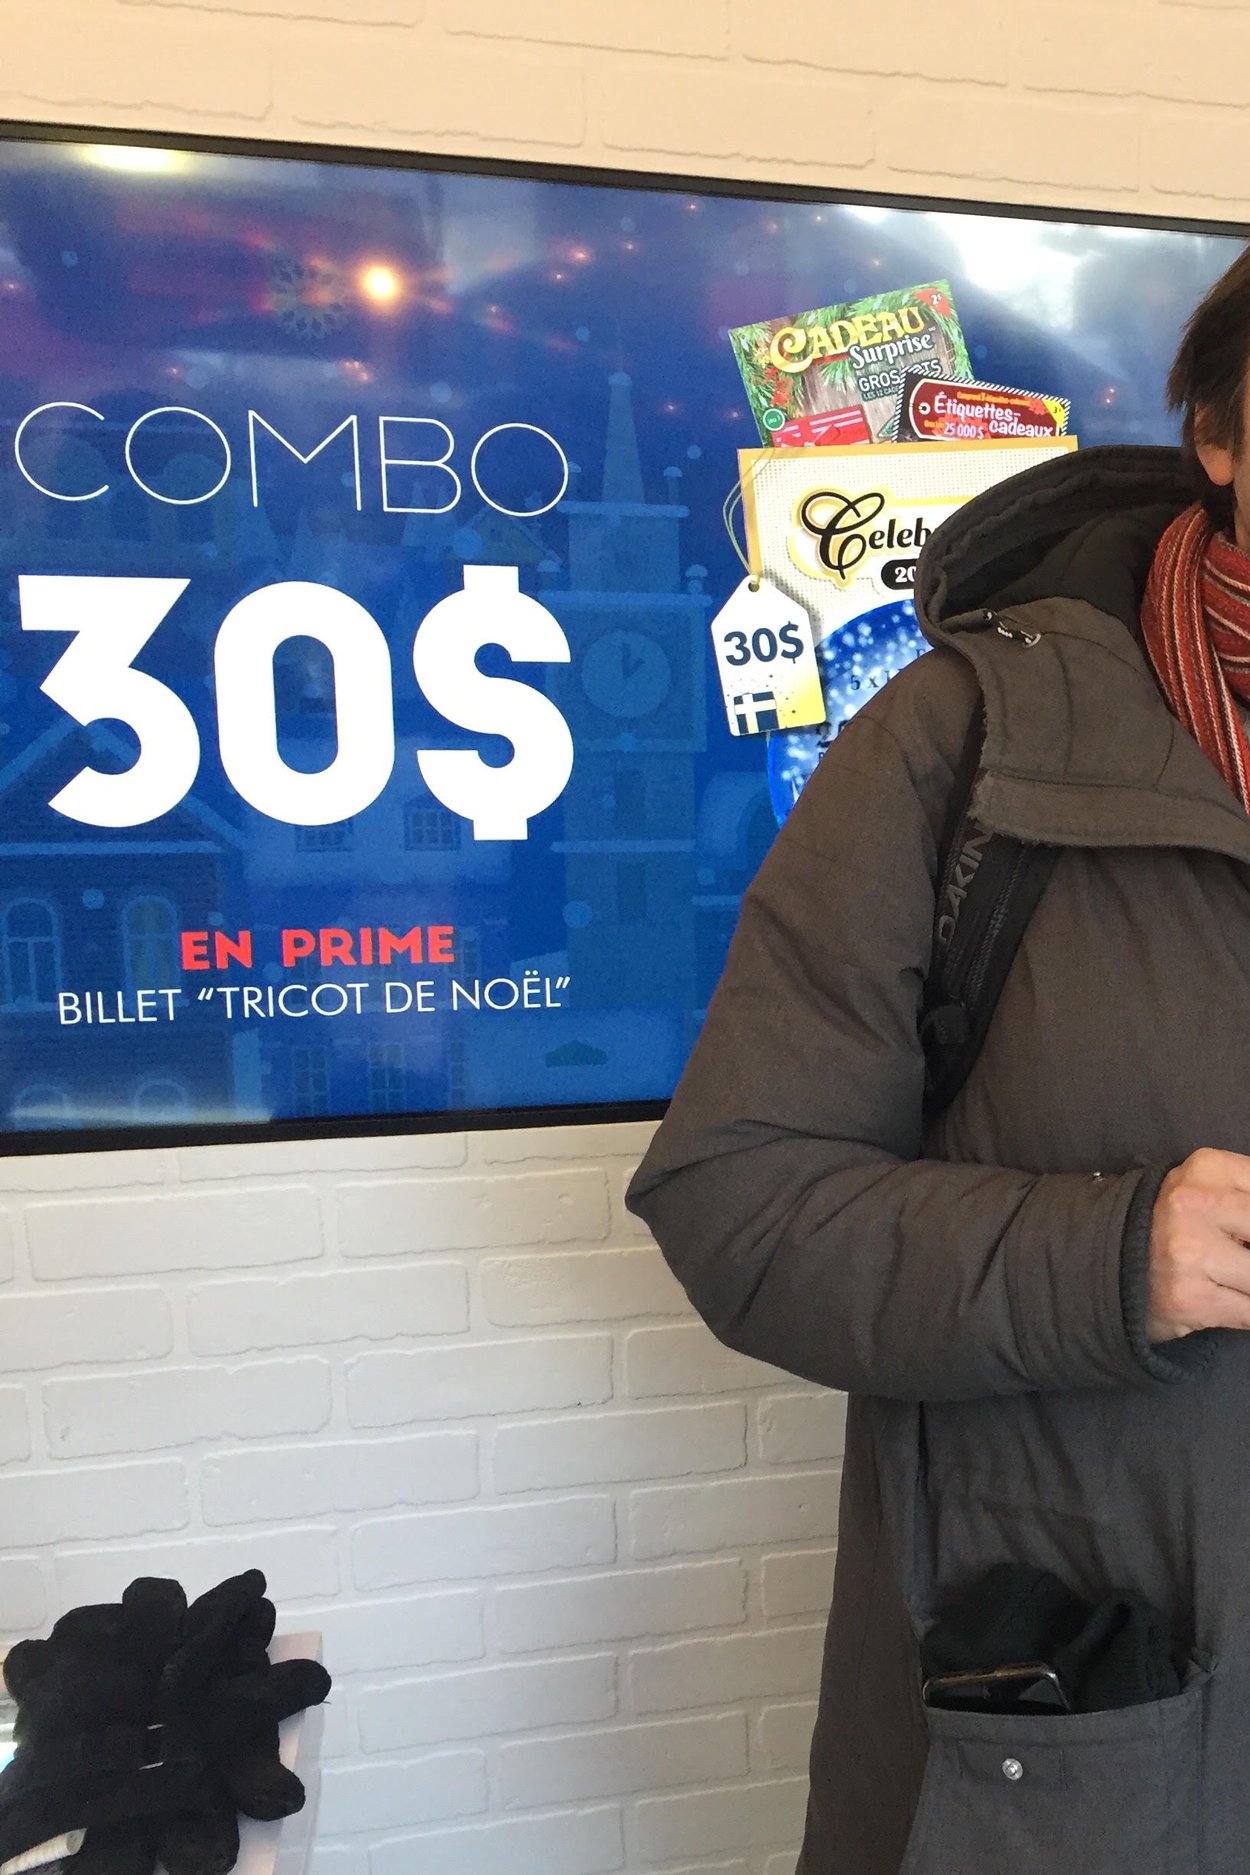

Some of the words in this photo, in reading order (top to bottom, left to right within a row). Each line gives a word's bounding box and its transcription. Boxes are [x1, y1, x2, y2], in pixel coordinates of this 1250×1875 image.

[769, 307, 925, 373] CADEAU
[849, 334, 934, 369] Surprise
[859, 370, 901, 392] GROS
[989, 418, 1054, 438] cadeaux
[14, 401, 570, 517] COMBO
[723, 621, 805, 667] 30$
[17, 564, 575, 841] 30$
[180, 930, 253, 971] EN
[282, 925, 456, 968] PRIME
[58, 988, 181, 1026] BILLET
[385, 981, 436, 1013] DE
